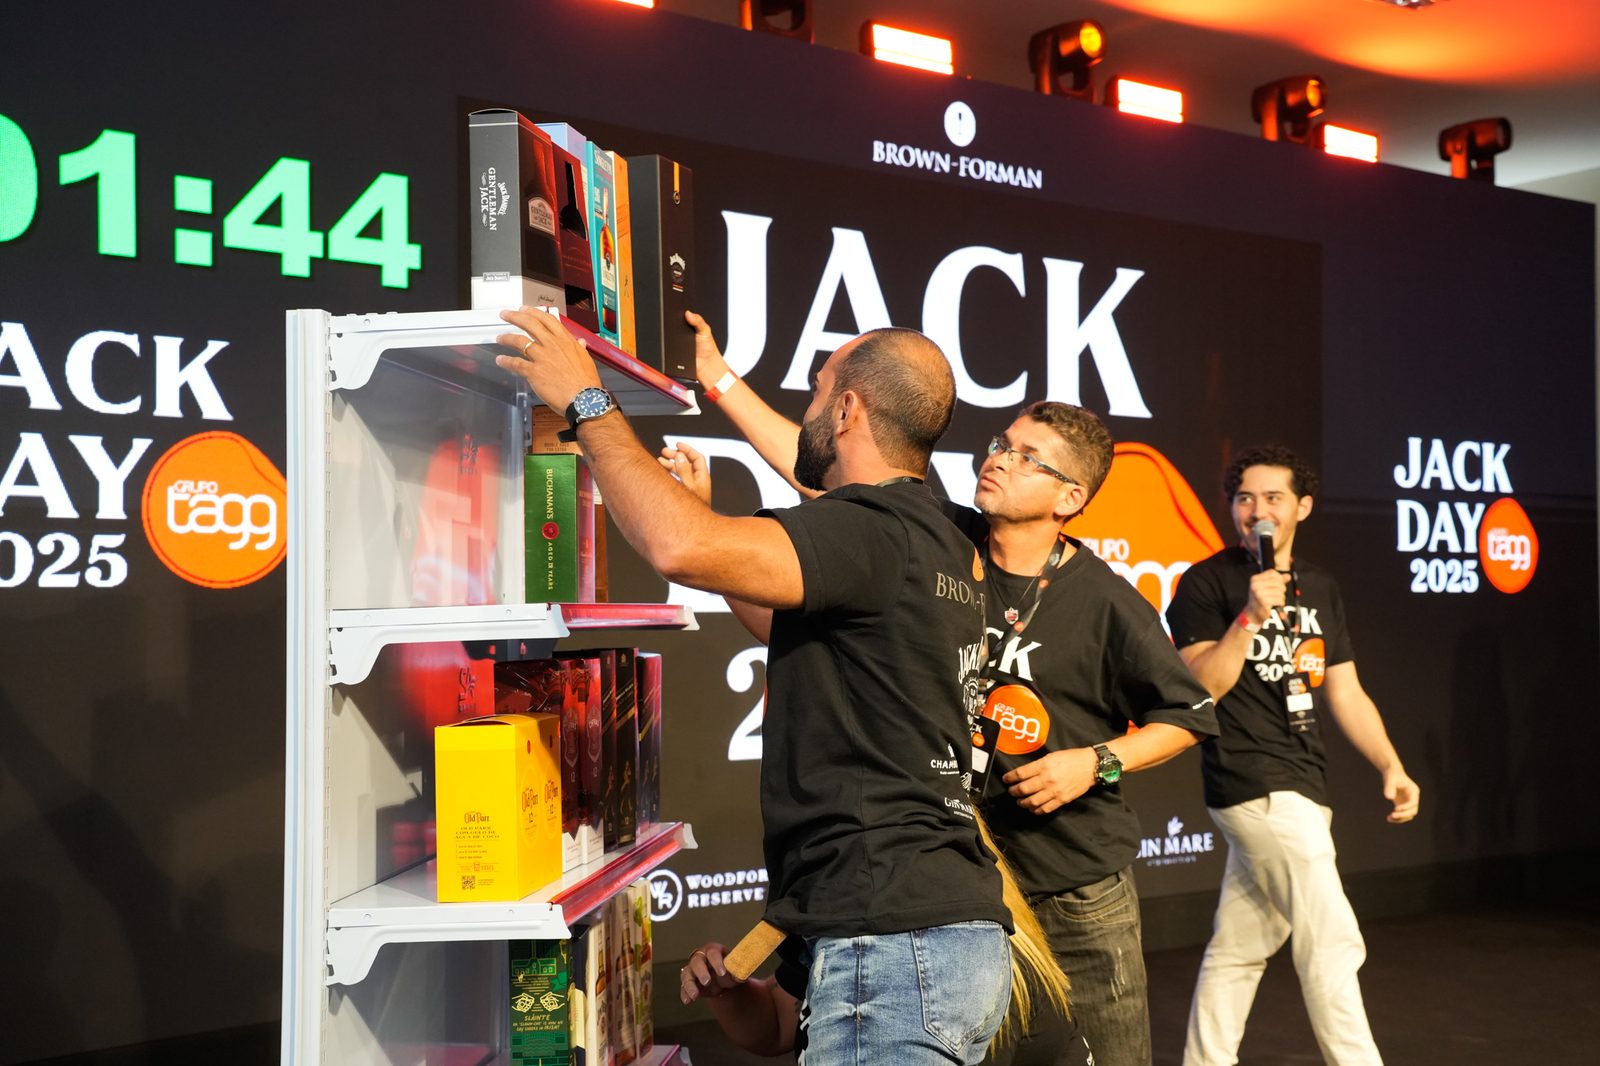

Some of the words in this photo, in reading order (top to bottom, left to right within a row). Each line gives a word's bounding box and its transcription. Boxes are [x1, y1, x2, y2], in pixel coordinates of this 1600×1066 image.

[873, 140, 1043, 190] BROWN-FORMAN
[479, 187, 489, 213] JACK
[488, 167, 497, 231] GENTLEMAN
[722, 210, 1153, 418] JACK
[173, 480, 219, 494] GRUPO
[1393, 436, 1514, 494] JACK
[166, 485, 278, 550] tagg
[546, 468, 554, 520] BUCHANAN'S
[1396, 499, 1486, 554] DAY
[1410, 557, 1480, 594] 2025
[464, 812, 476, 824] Old
[477, 812, 490, 823] Parr
[1136, 837, 1162, 859] IN
[1163, 832, 1214, 855] MARE
[688, 887, 765, 908] RESERVE
